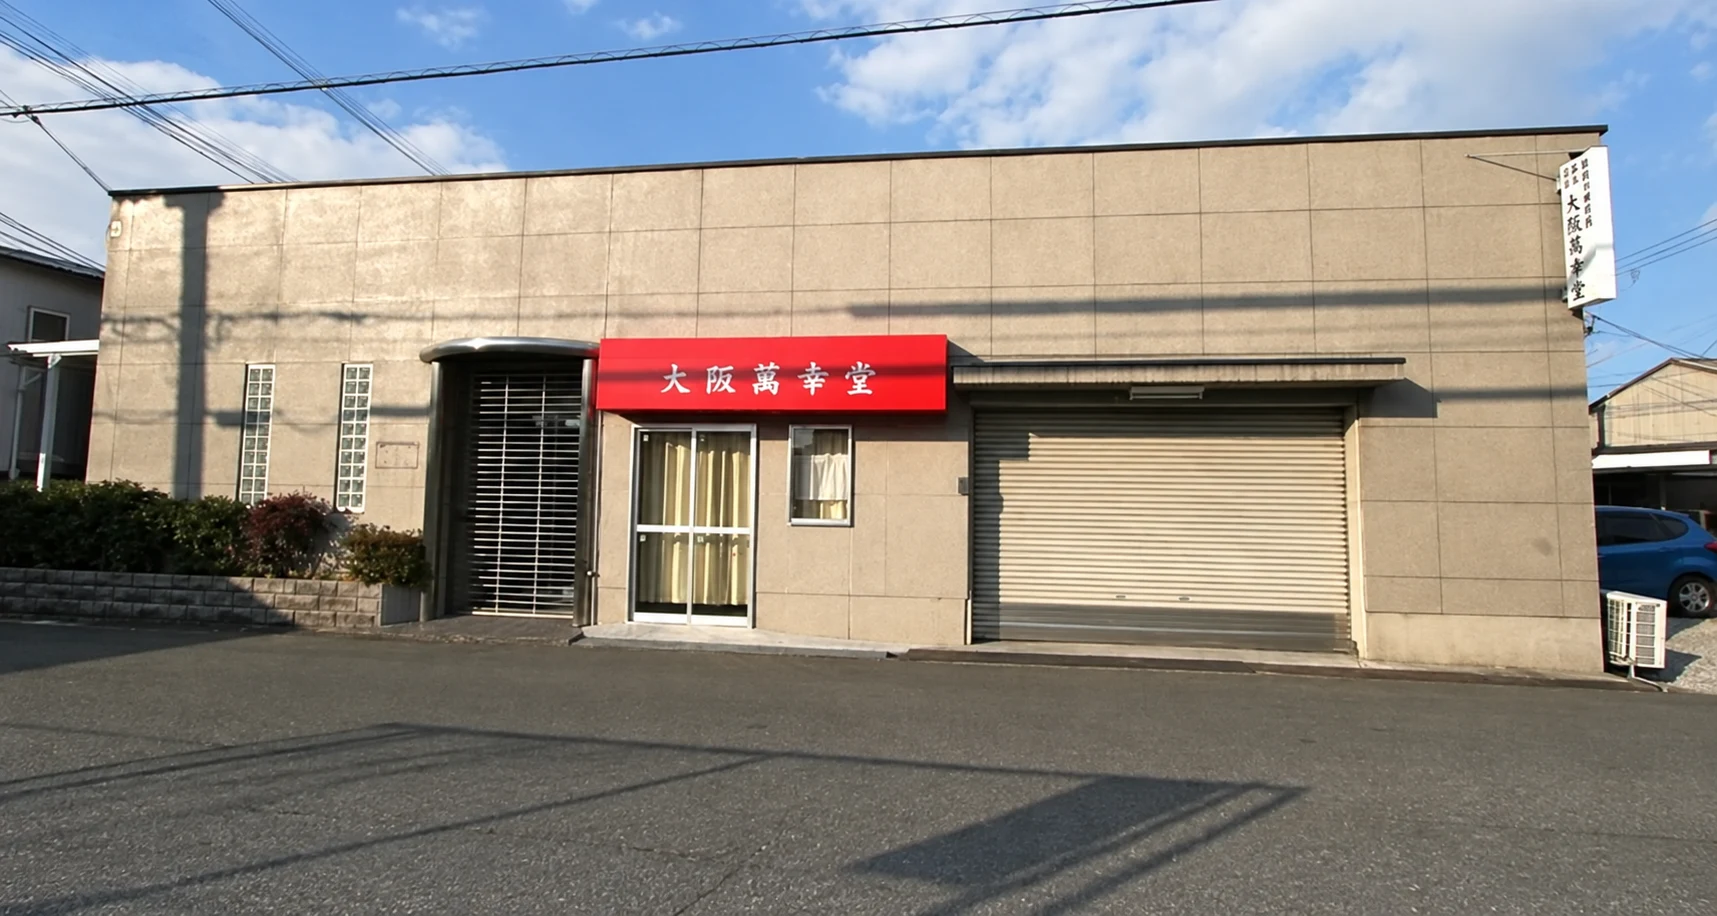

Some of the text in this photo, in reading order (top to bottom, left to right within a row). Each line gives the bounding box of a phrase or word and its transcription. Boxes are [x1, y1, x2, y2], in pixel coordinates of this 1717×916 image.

[1566, 194, 1586, 302] 大阪萬幸堂
[661, 361, 877, 396] 大阪萬幸堂
